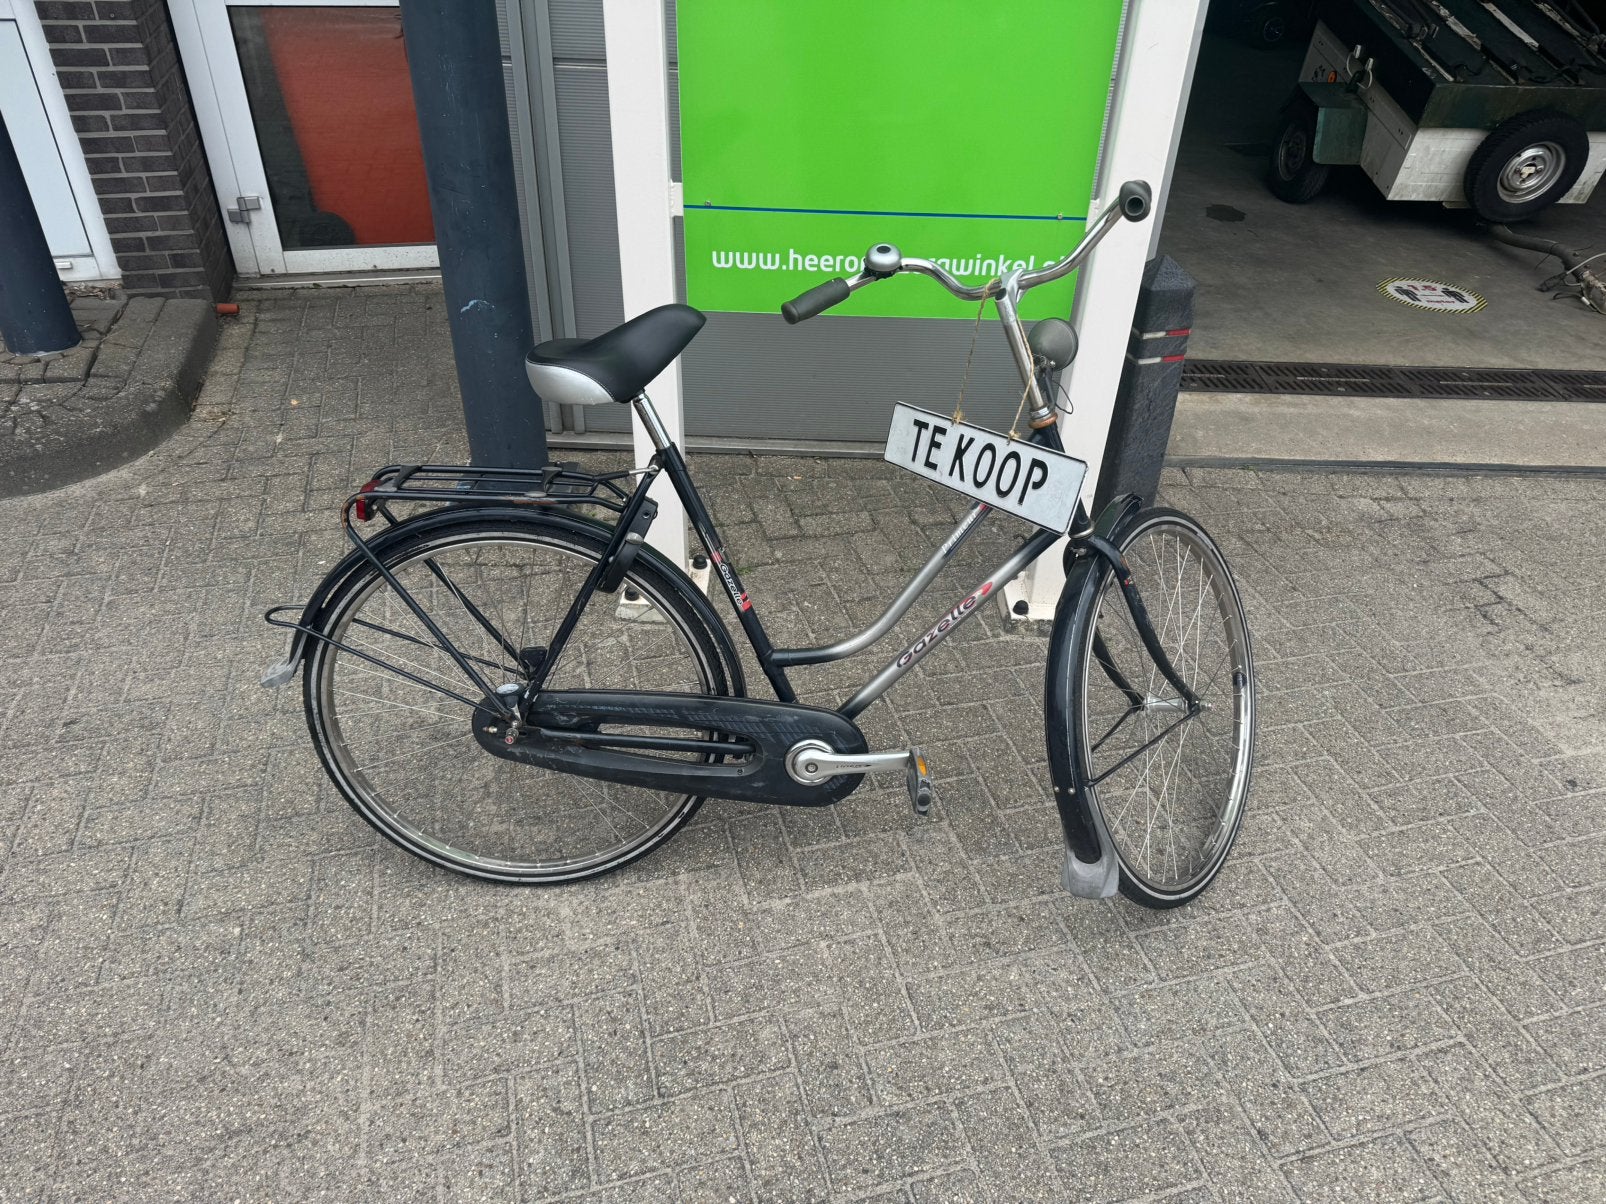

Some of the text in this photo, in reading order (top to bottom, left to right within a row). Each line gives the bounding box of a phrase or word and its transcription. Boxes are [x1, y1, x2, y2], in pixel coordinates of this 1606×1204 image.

[911, 418, 1049, 505] TE KOOP
[720, 563, 744, 605] Gazelle
[896, 595, 977, 668] Gazelle
